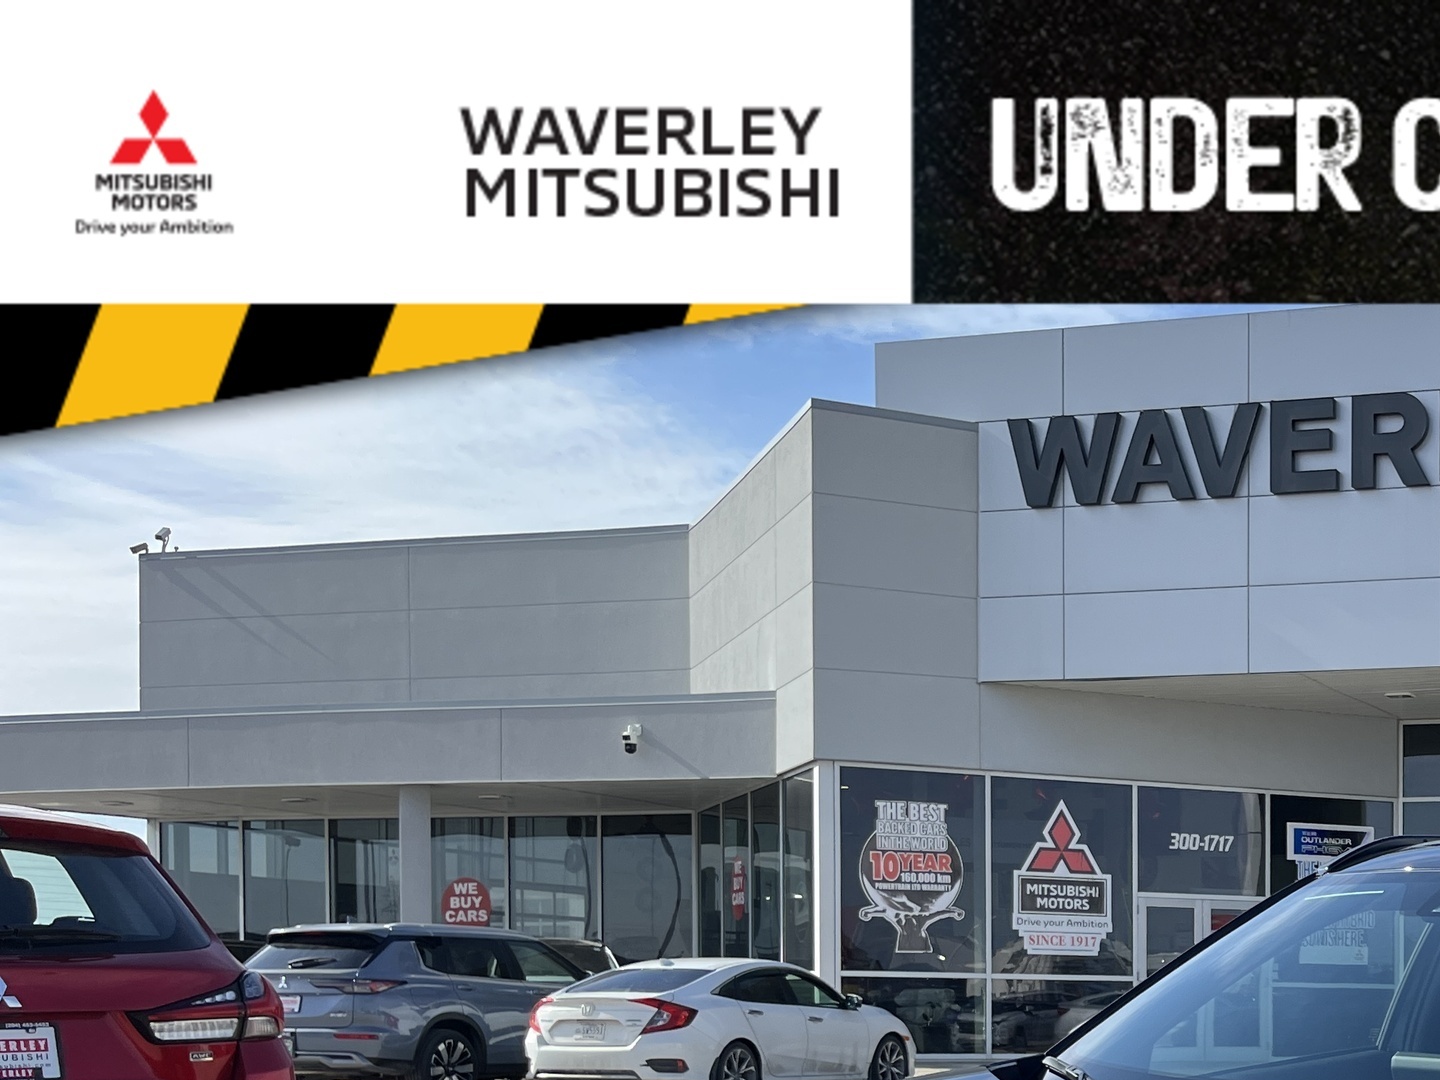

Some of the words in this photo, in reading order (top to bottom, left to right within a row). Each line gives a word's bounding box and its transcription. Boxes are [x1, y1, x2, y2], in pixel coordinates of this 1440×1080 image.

[876, 800, 906, 821] THE
[909, 802, 948, 822] BEST
[878, 820, 917, 835] BACKED
[920, 822, 947, 836] CARS
[911, 837, 947, 850] WORLD
[1169, 832, 1235, 852] 300-1717
[1301, 836, 1352, 846] OUTLANDER
[870, 851, 900, 881] 10
[898, 853, 952, 872] YEAR
[900, 872, 935, 883] 160,000
[937, 874, 951, 883] km
[453, 882, 479, 895] WE
[1026, 883, 1099, 898] MITSUBISHI
[449, 896, 483, 909] BUY
[1036, 897, 1090, 910] MOTORS
[445, 909, 489, 923] CARS
[1017, 917, 1041, 927] Drive
[1044, 919, 1064, 929] your
[1066, 918, 1109, 929] Ambition
[1028, 934, 1067, 947] SINCE
[1071, 935, 1097, 948] 1917
[0, 1069, 33, 1078] ERLEY
